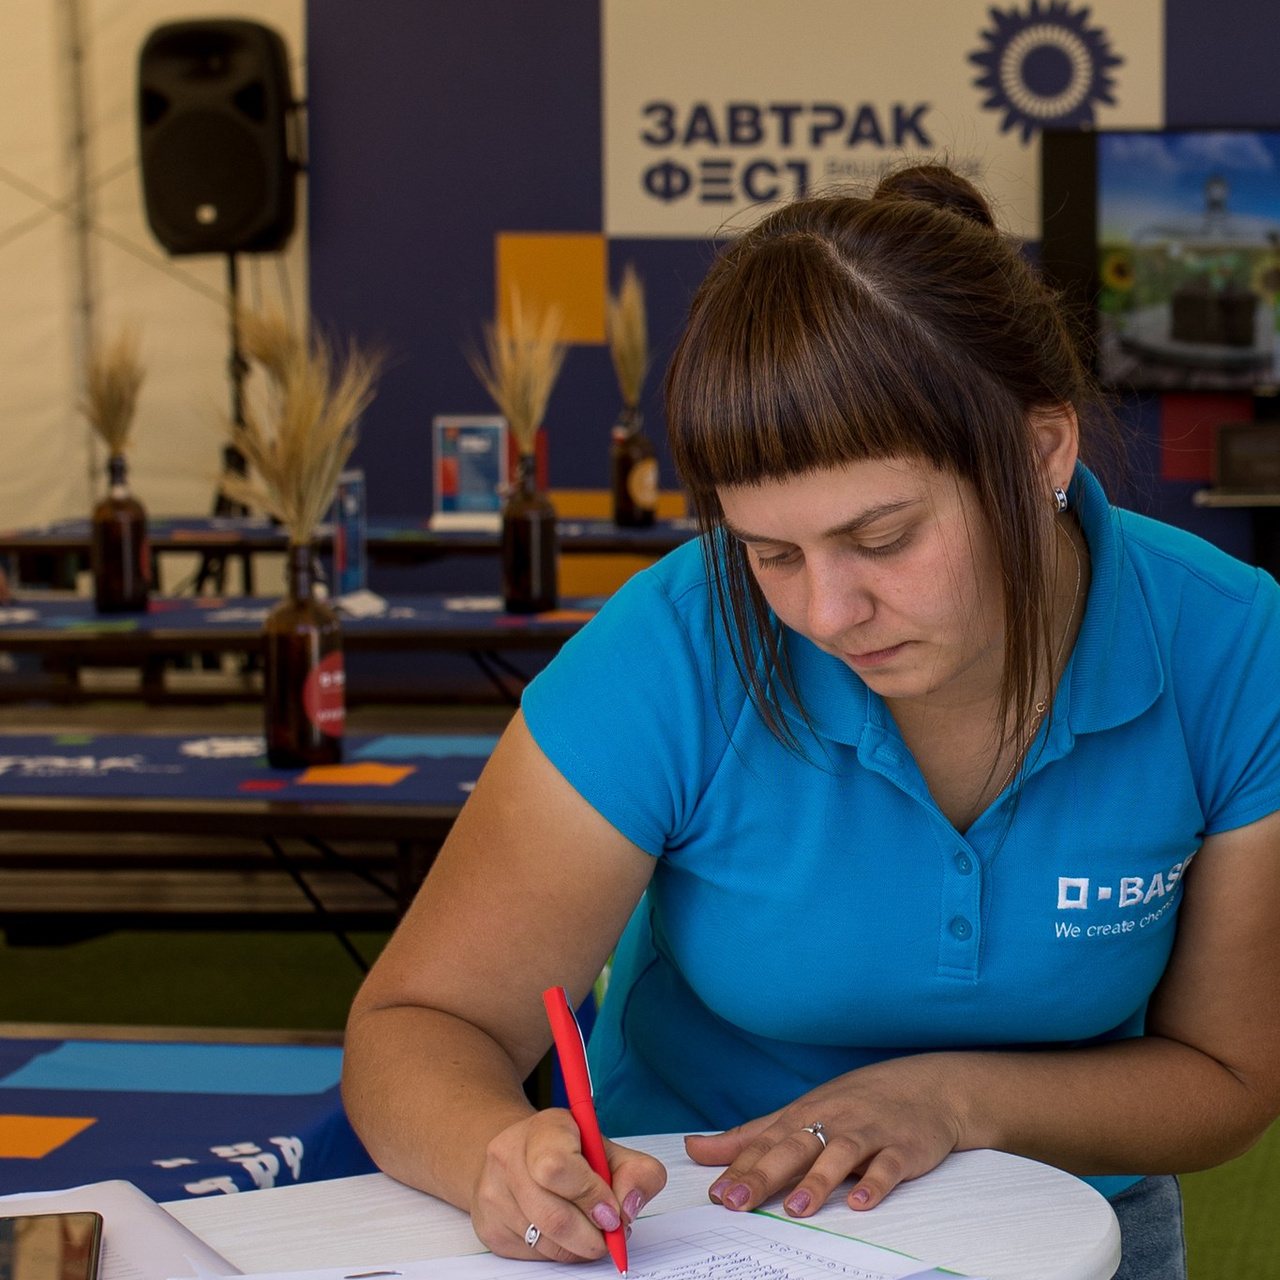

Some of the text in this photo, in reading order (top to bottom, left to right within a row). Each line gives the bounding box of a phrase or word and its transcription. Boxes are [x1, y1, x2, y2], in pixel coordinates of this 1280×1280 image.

[640, 101, 934, 148] ЗАВТРАК
[1054, 922, 1081, 938] We
[1087, 920, 1135, 937] create
